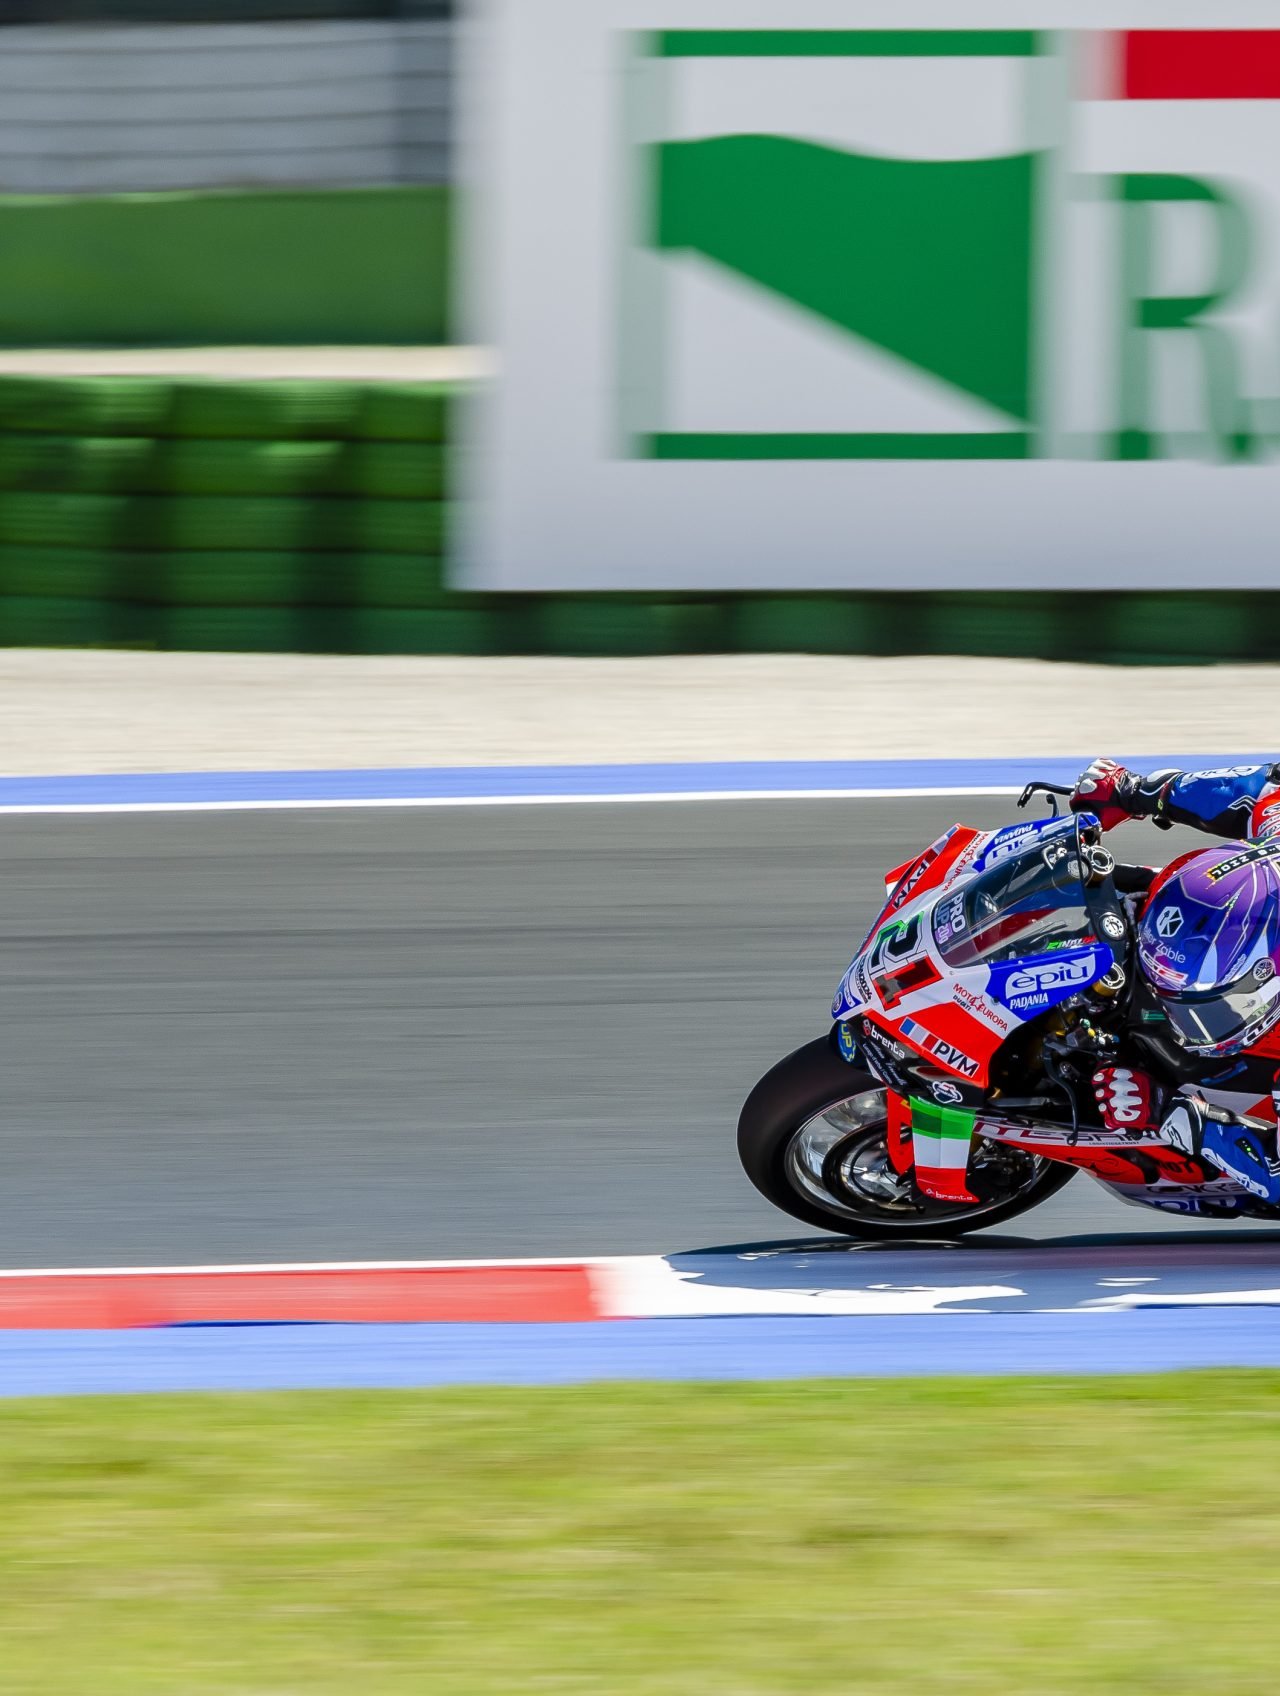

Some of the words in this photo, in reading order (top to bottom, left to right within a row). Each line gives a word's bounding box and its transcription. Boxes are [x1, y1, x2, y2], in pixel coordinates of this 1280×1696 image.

[892, 863, 928, 909] PVM
[950, 891, 966, 933] PRO
[1012, 964, 1090, 993] epiu
[1008, 992, 1050, 1010] PADANIA
[870, 1025, 906, 1059] brenta
[934, 1041, 980, 1077] PVM
